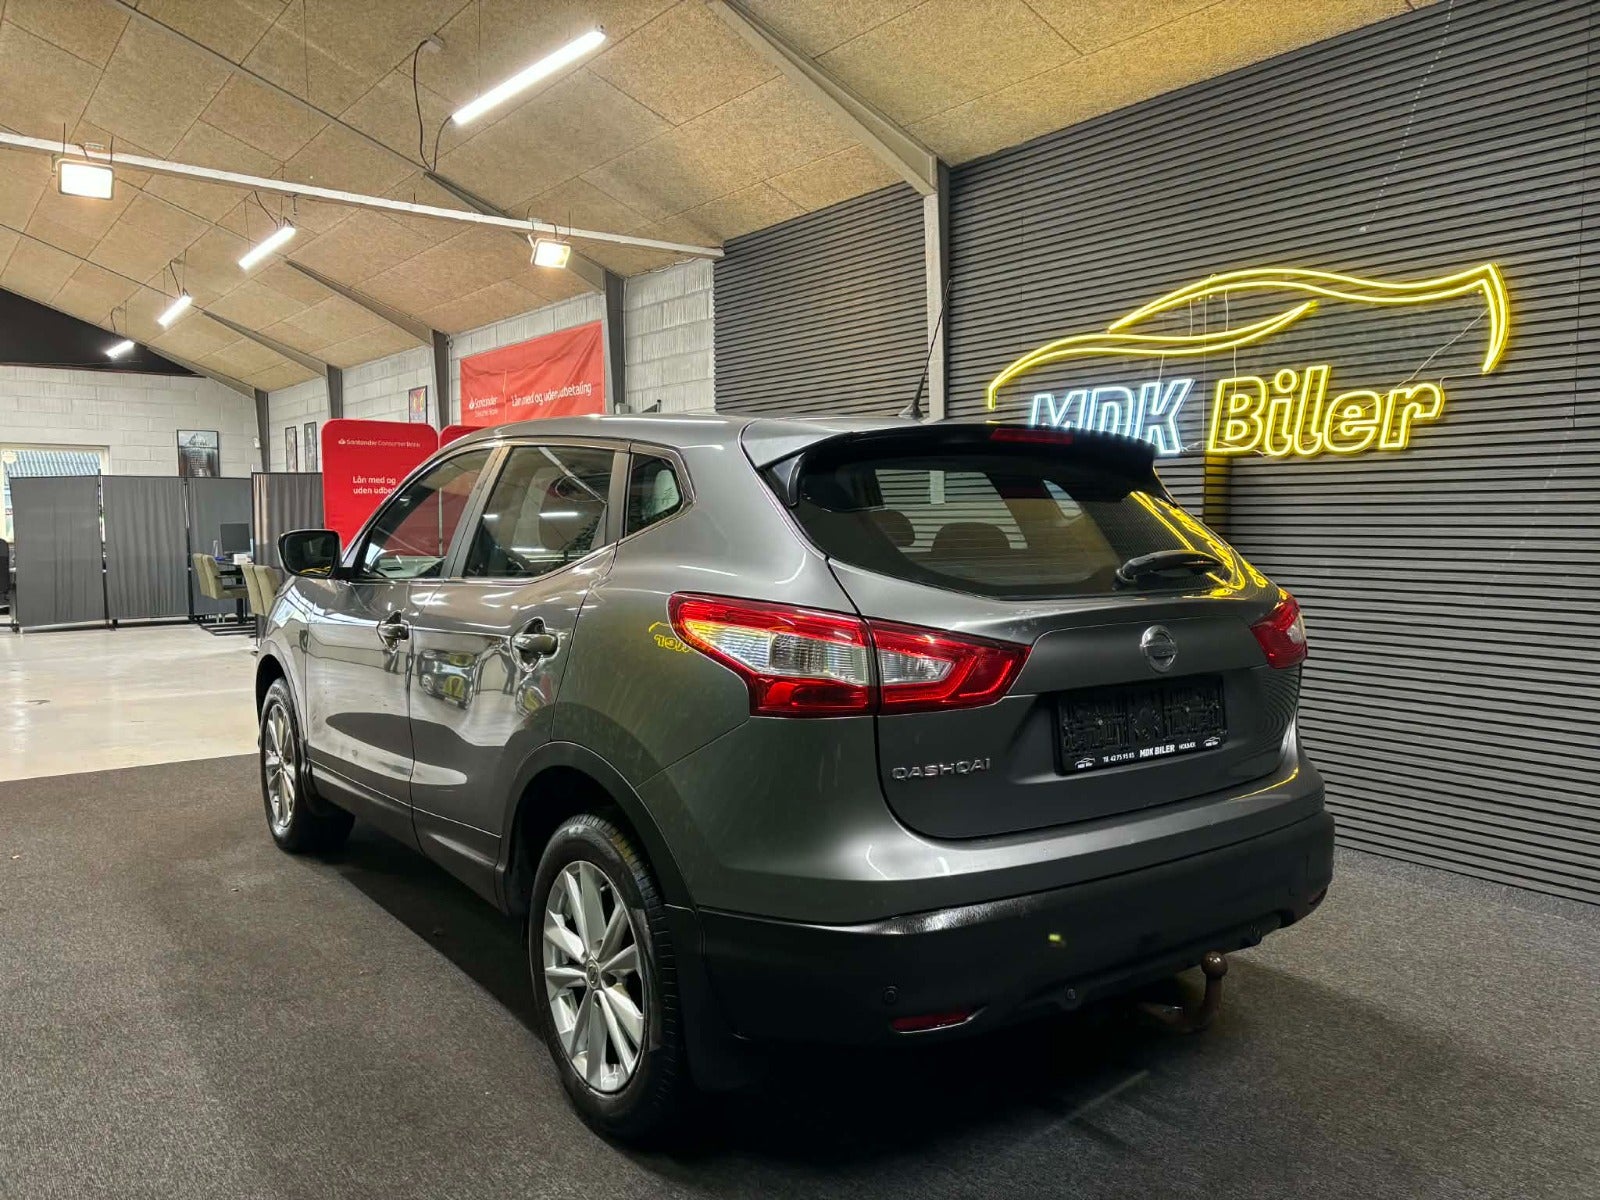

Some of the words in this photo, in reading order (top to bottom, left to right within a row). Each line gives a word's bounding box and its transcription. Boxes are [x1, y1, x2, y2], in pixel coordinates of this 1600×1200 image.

[535, 391, 544, 406] og
[1207, 363, 1446, 457] Biler
[352, 475, 367, 484] Lån
[368, 476, 385, 484] med
[386, 477, 397, 486] og
[353, 486, 373, 495] uden
[1154, 744, 1176, 756] BILER
[892, 758, 990, 781] QASHQAI
